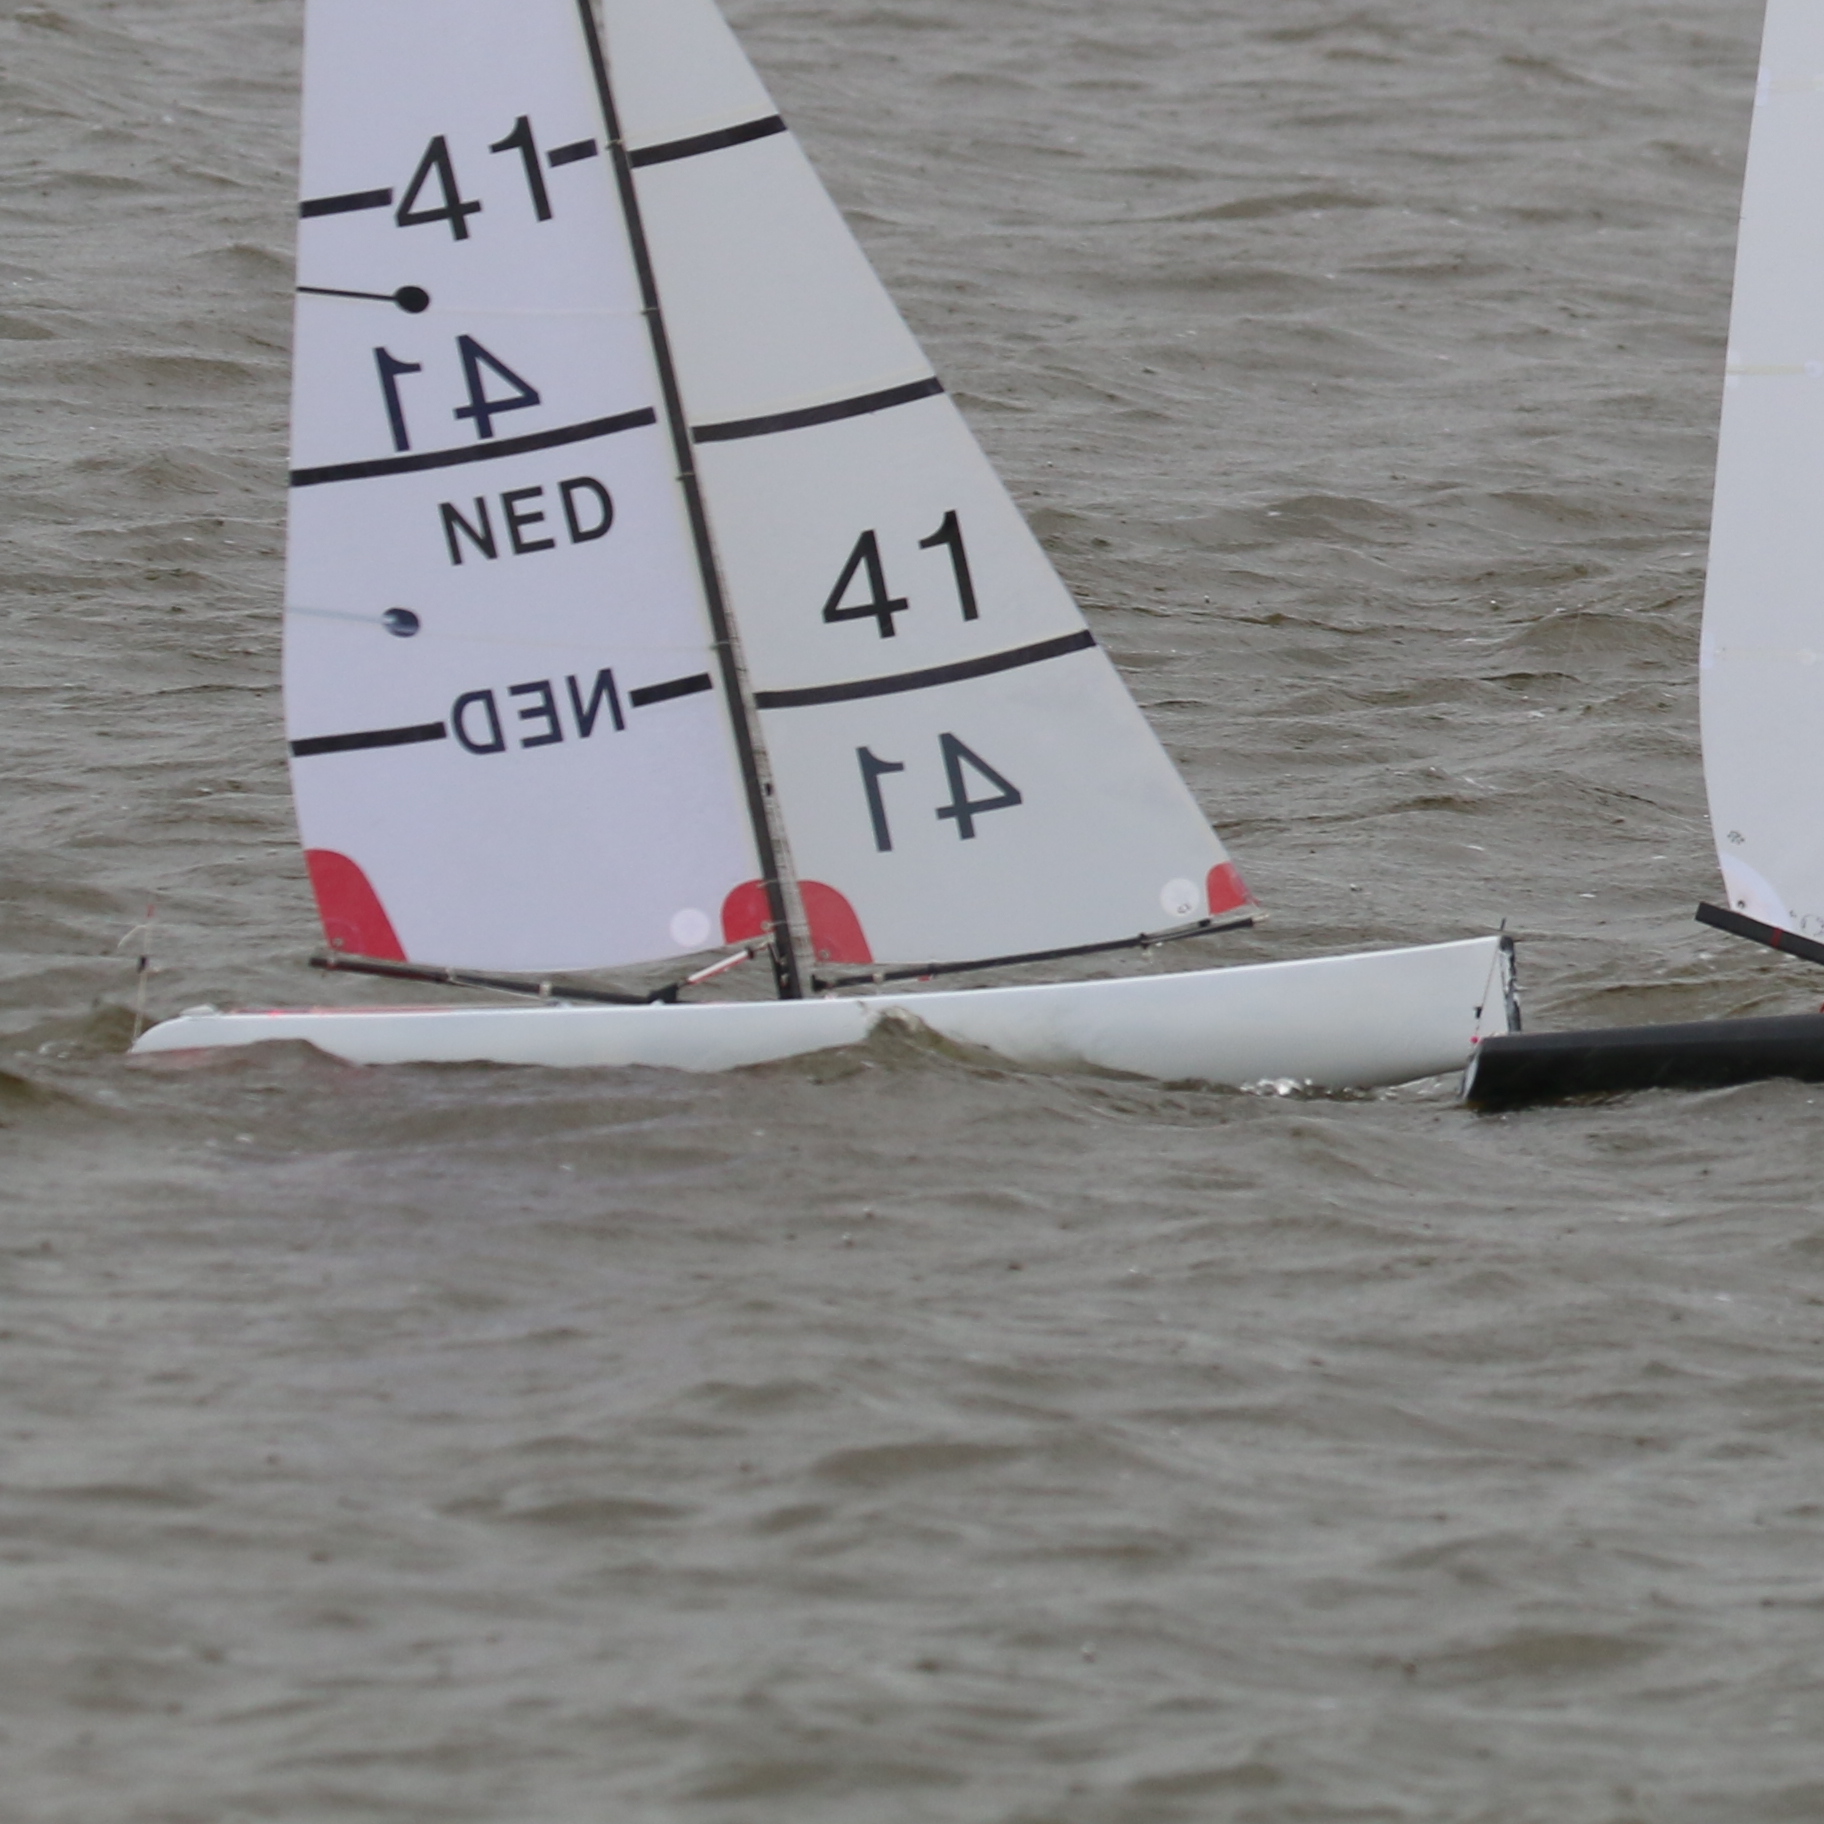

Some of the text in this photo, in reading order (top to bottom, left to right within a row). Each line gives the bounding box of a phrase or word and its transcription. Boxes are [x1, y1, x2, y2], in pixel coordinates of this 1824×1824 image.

[395, 115, 553, 241] 41
[440, 477, 613, 565] NED
[823, 510, 978, 638] 41
